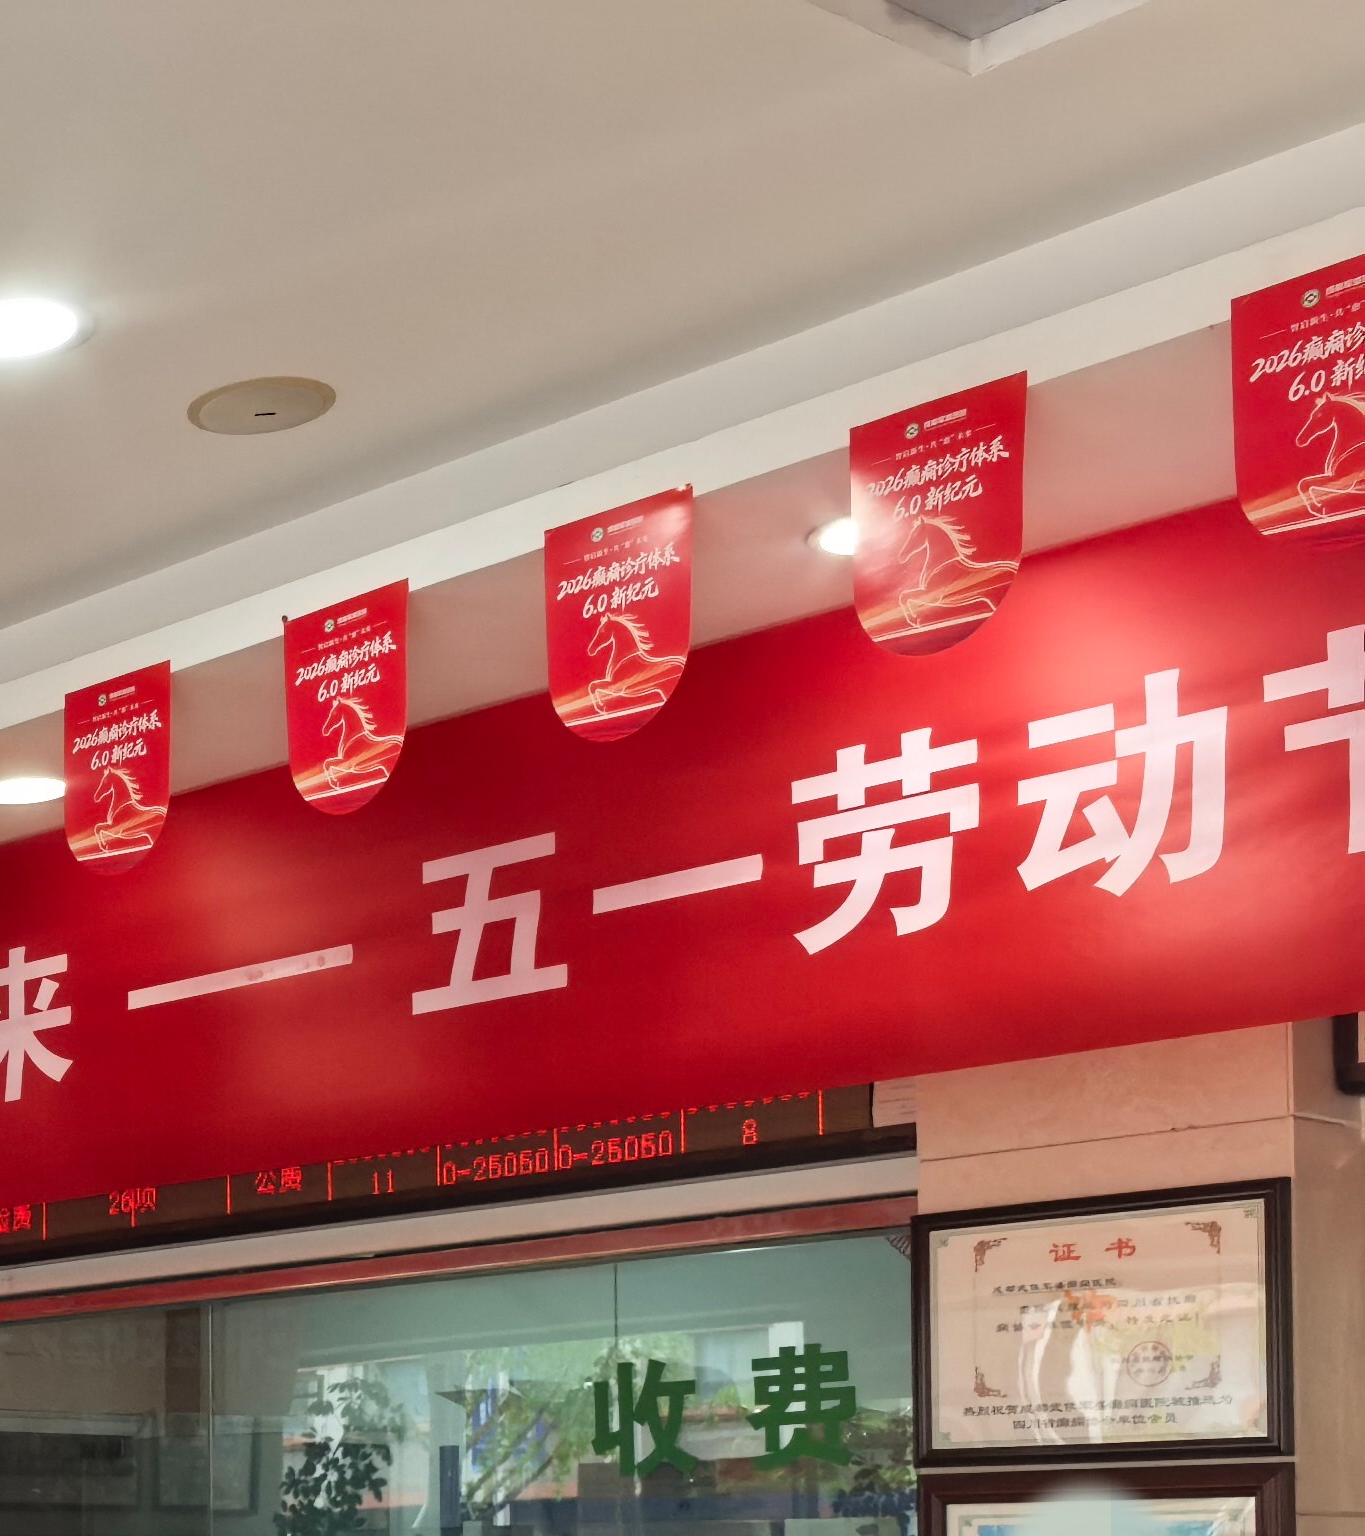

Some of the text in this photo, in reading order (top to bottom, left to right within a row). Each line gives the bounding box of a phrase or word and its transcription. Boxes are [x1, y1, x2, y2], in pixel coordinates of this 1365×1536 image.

[1288, 371, 1325, 402] 6.0
[893, 495, 922, 523] 6.0
[582, 594, 607, 619] 6.0
[317, 680, 339, 702] 6.0
[1049, 1237, 1137, 1263] 证书
[592, 1342, 857, 1480] 收费
